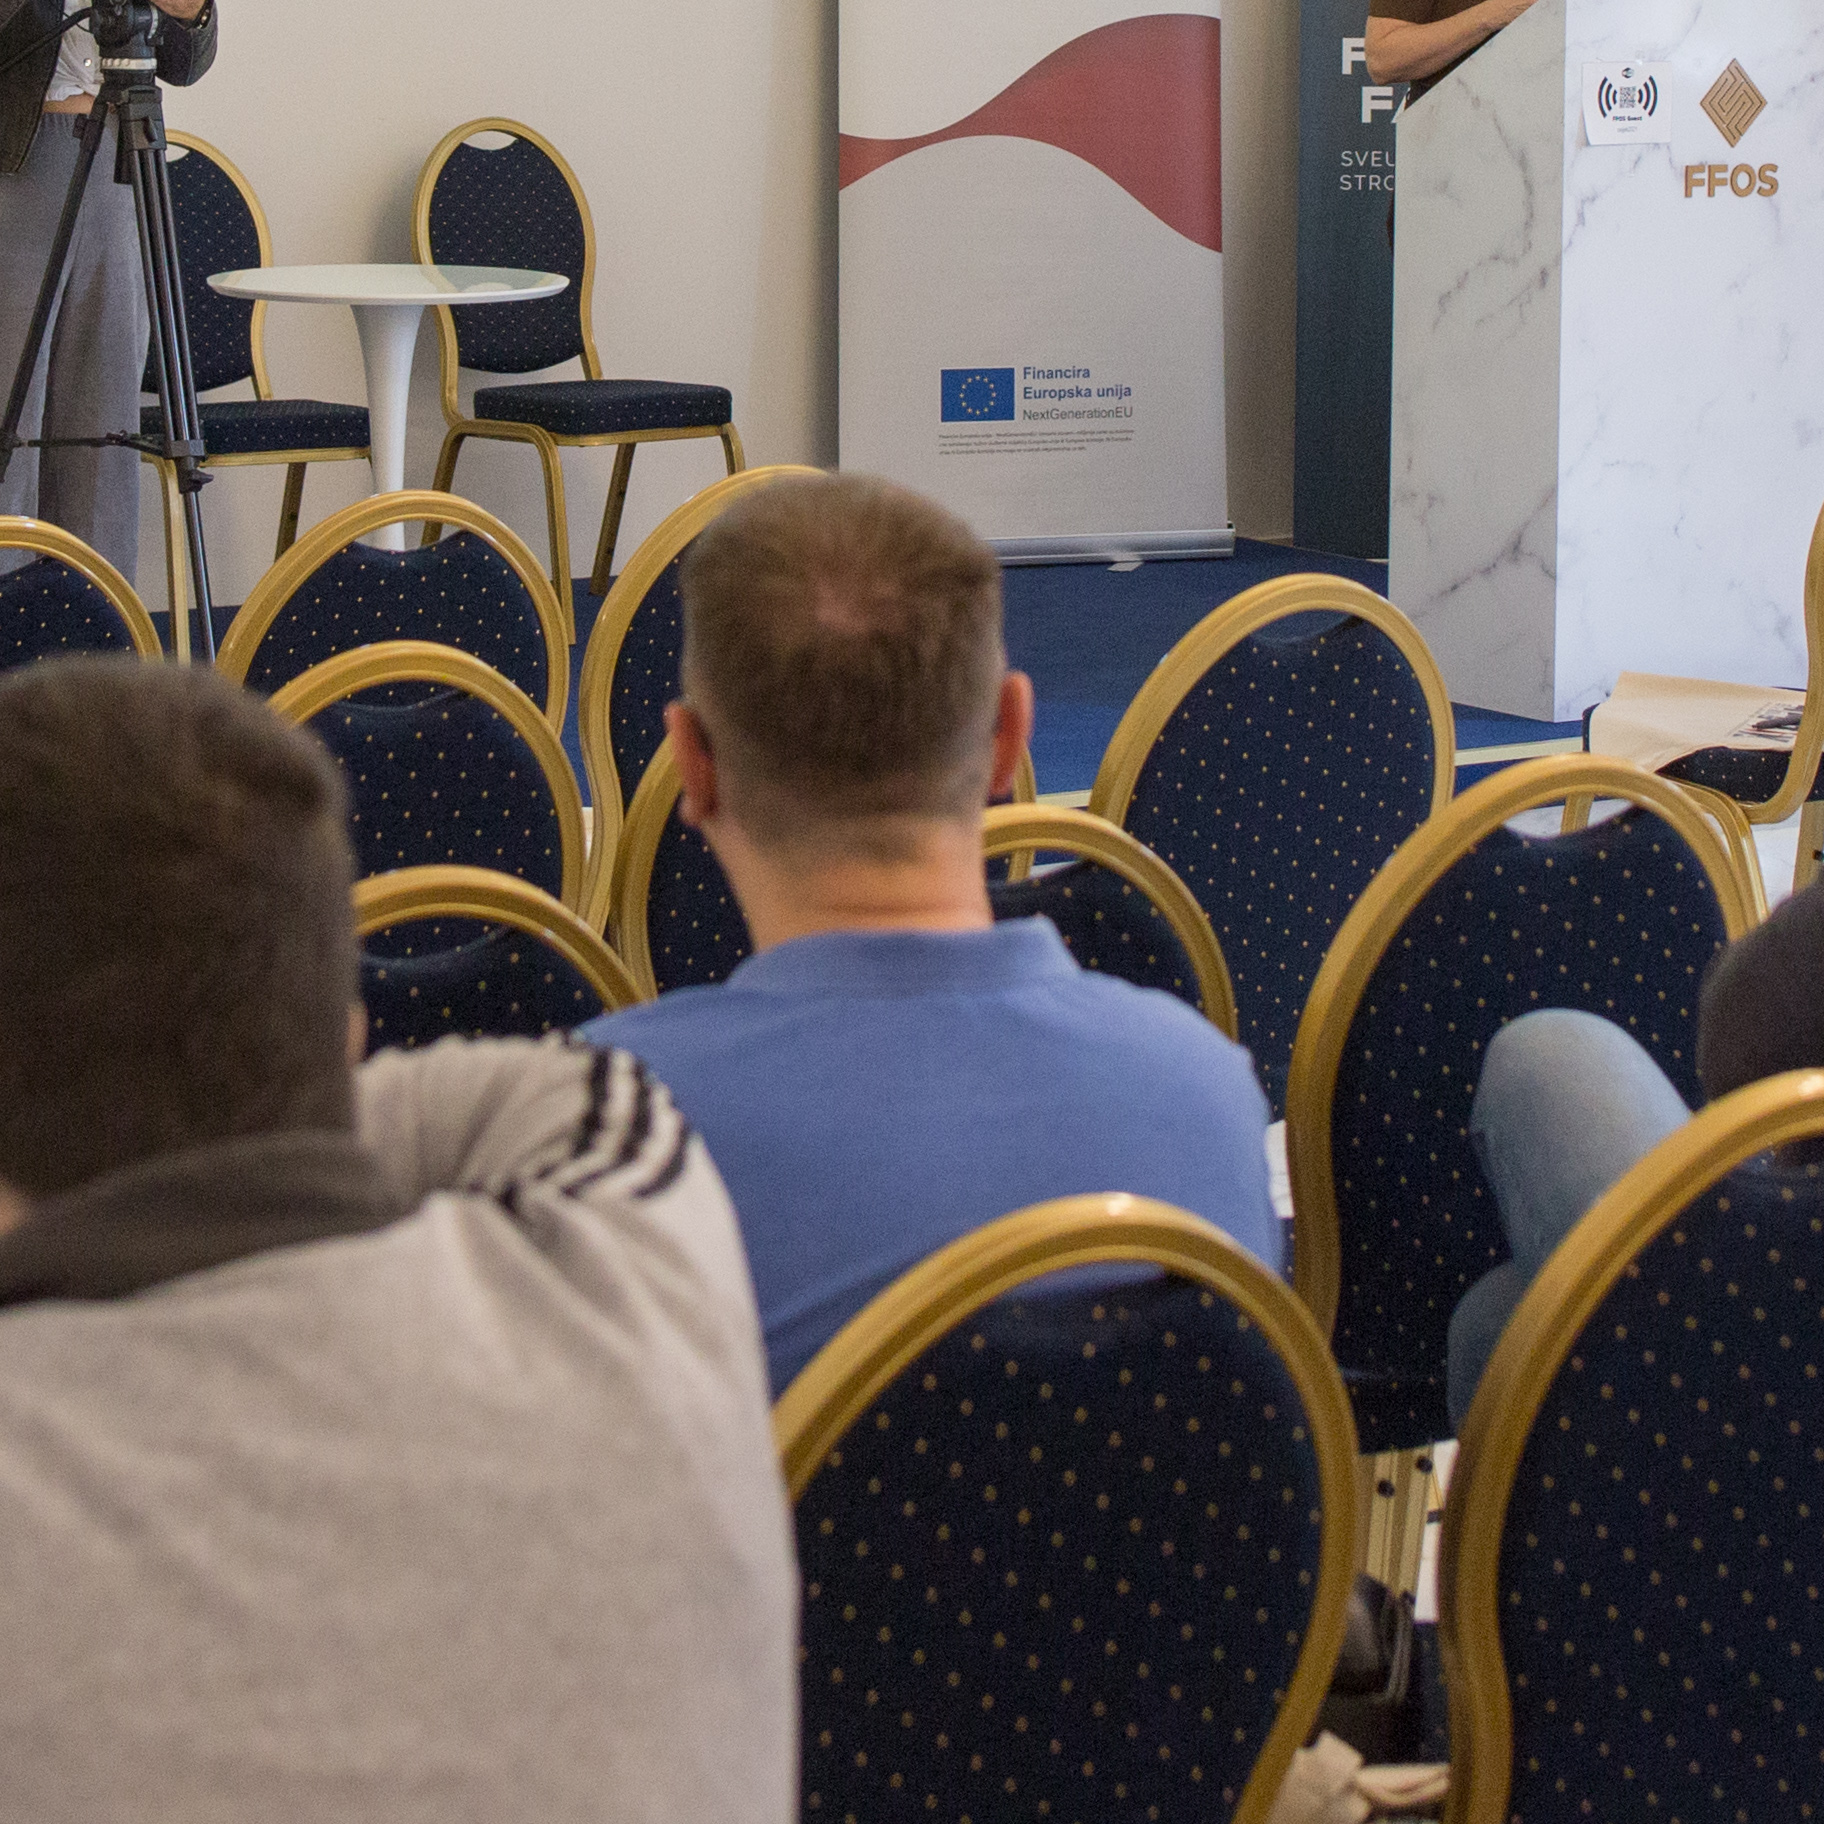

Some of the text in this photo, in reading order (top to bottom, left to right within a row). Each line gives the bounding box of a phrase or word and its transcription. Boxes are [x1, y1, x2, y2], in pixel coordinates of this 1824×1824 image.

[1684, 162, 1779, 198] FFOS
[1023, 366, 1091, 380] Financira
[1023, 384, 1132, 401] Europska unija
[1023, 406, 1134, 421] NextGenerationEU
